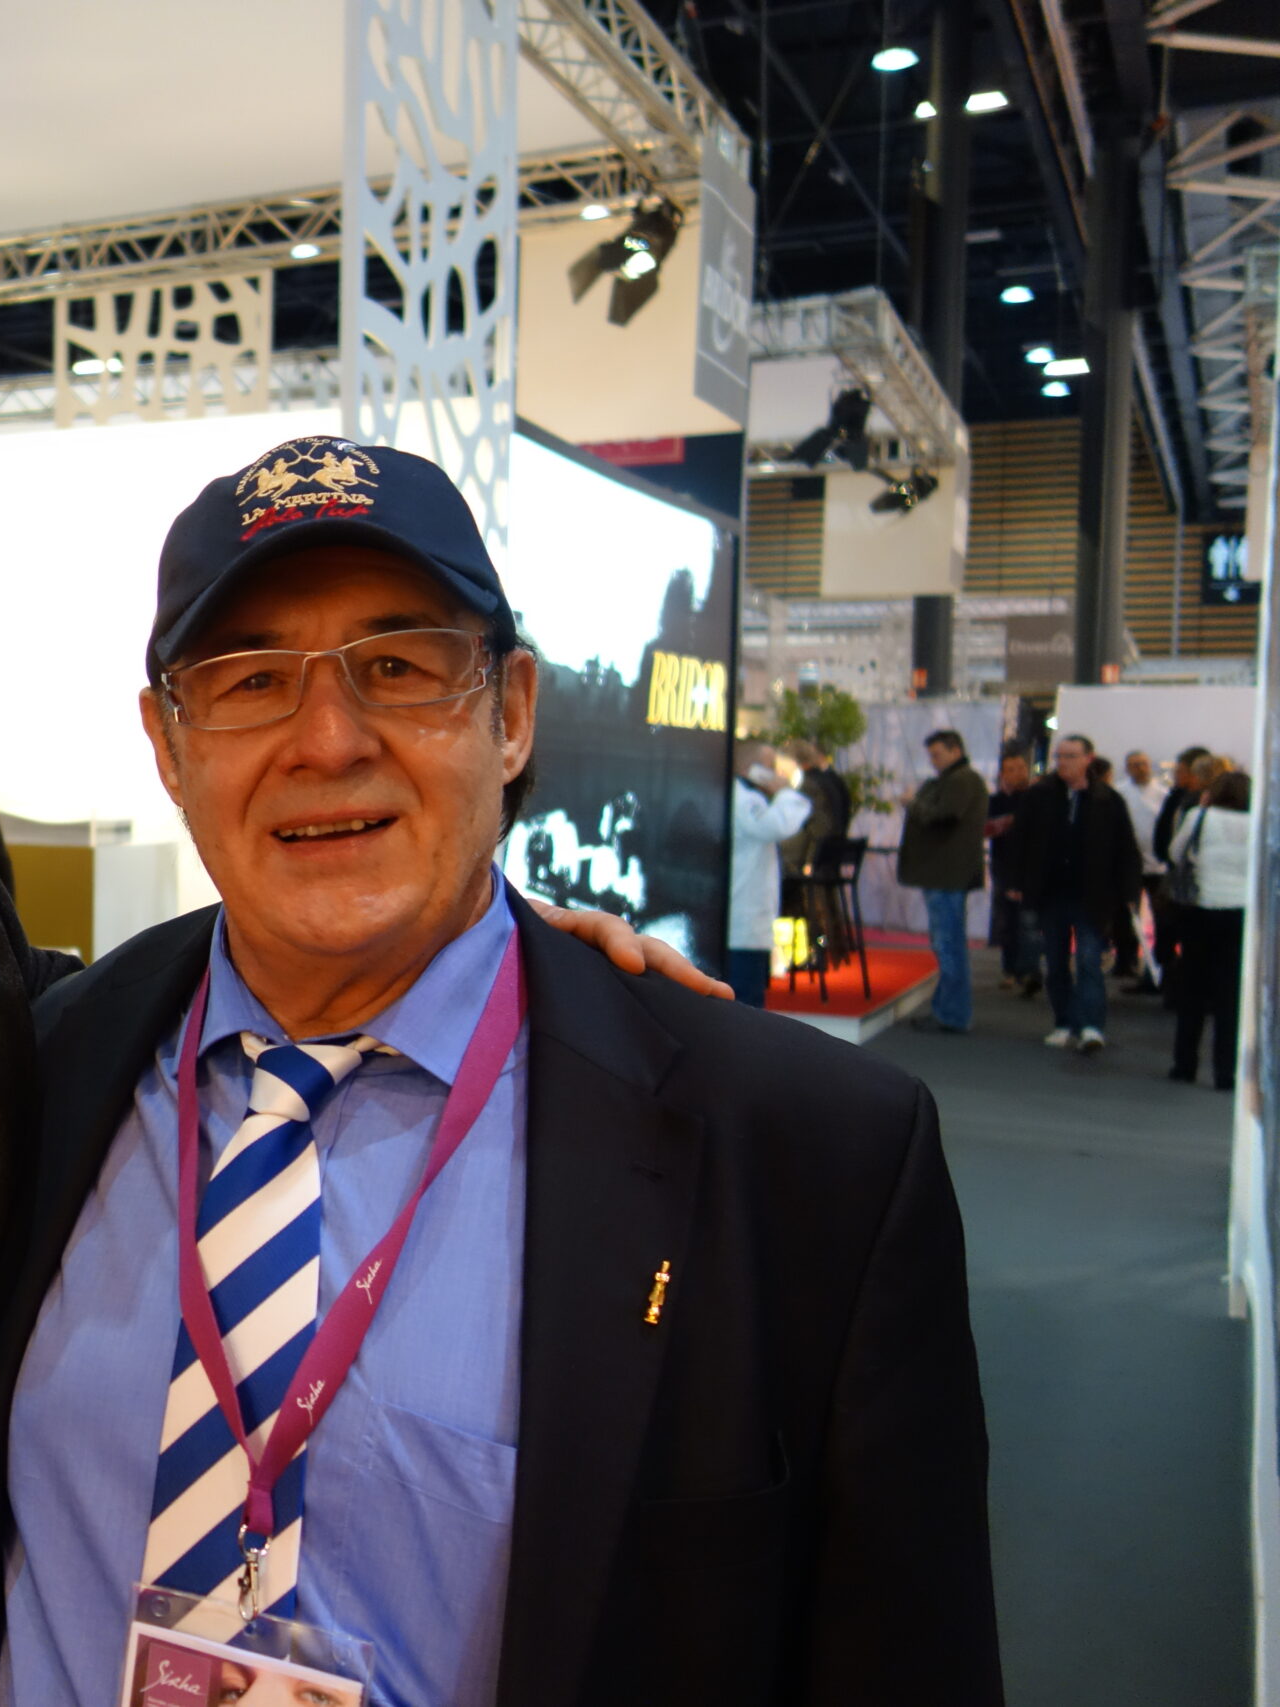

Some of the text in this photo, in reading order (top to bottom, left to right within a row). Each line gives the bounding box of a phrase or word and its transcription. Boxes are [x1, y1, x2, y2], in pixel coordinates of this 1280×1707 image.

[241, 492, 374, 526] LA MARTINA
[645, 651, 727, 732] BRIDOR
[139, 1660, 206, 1696] Sirha
